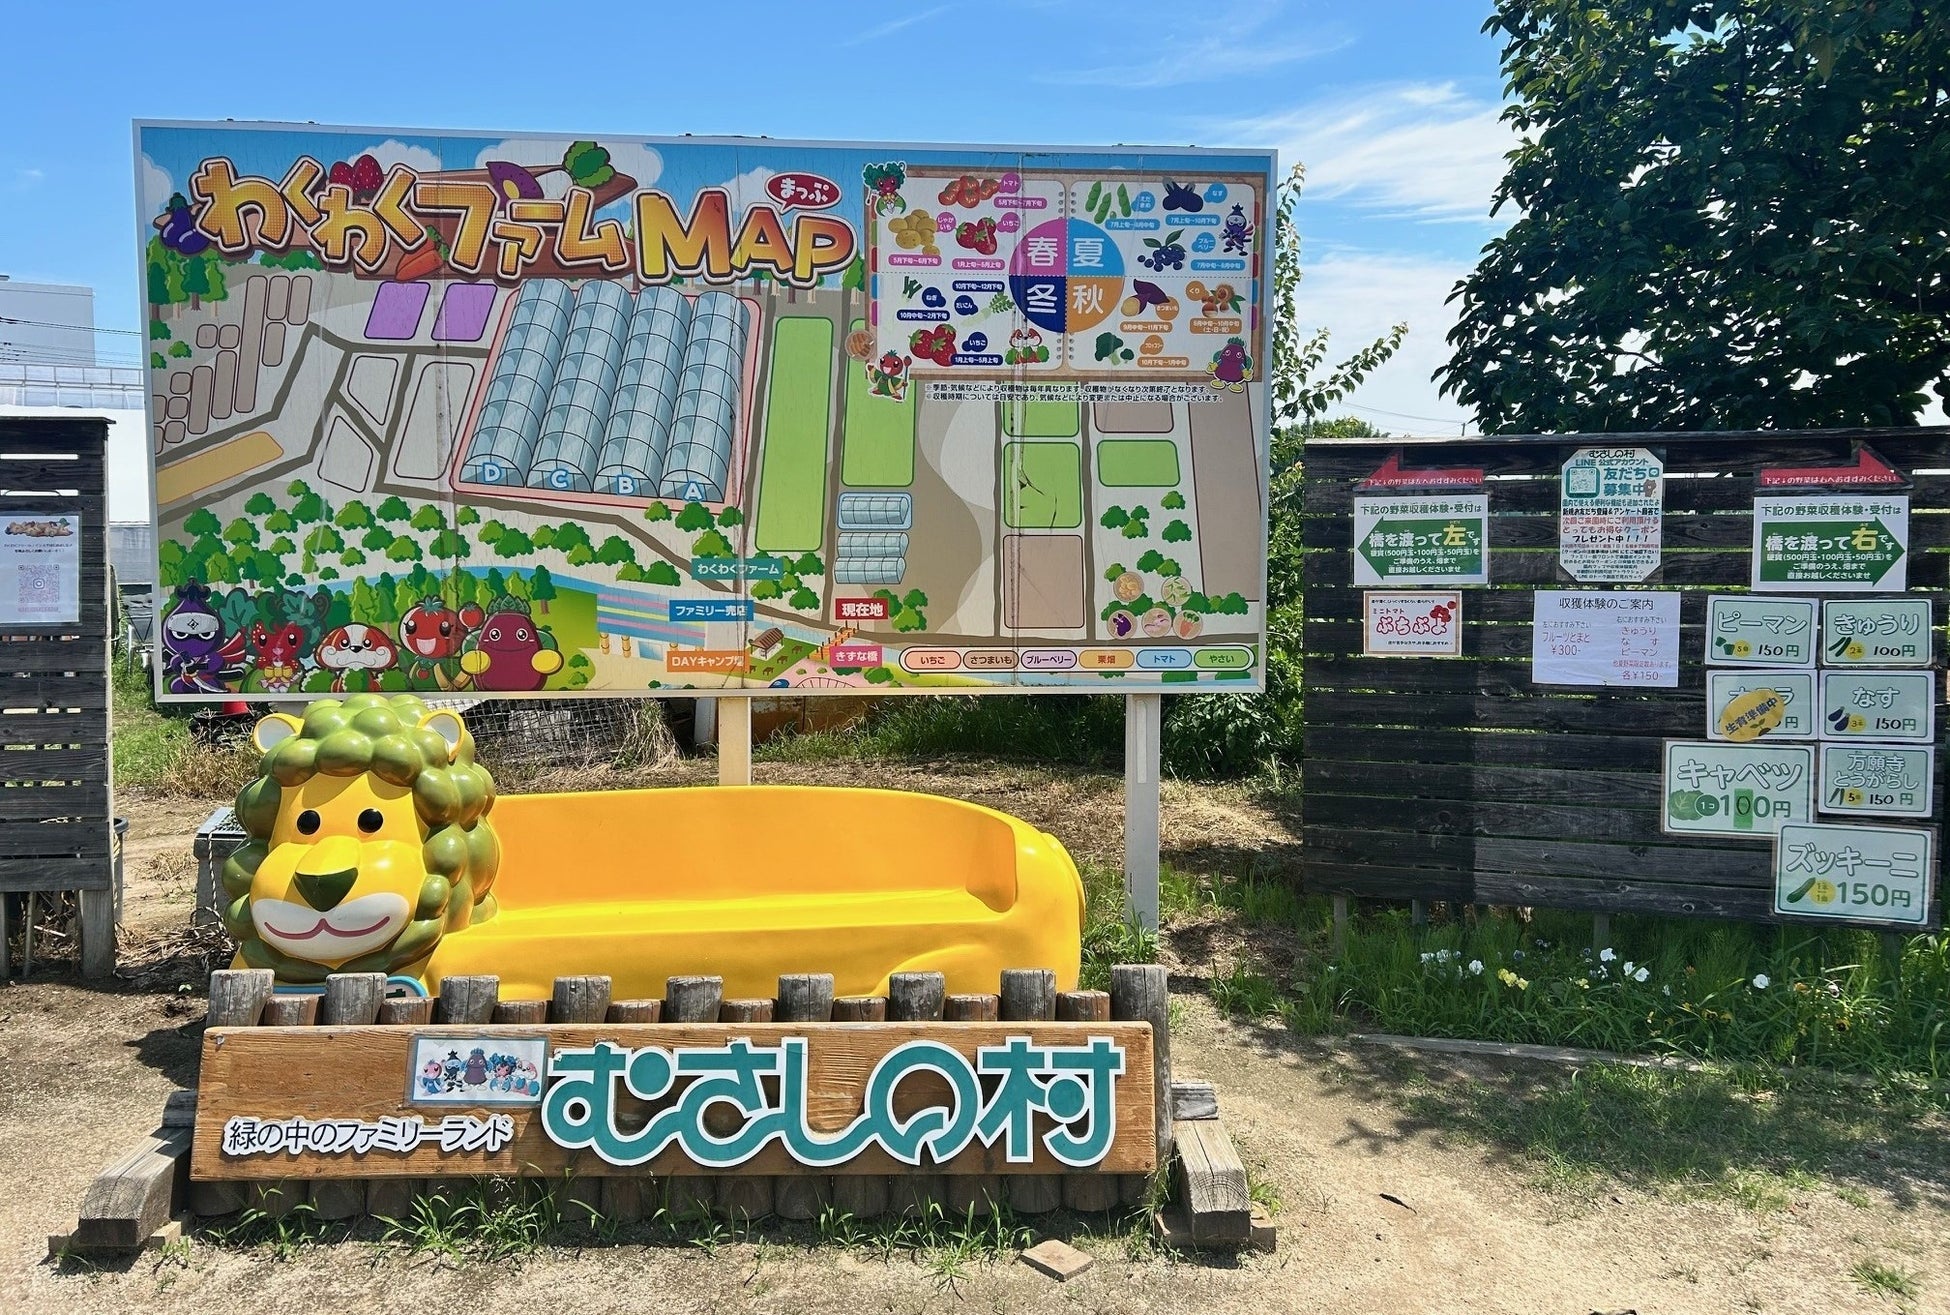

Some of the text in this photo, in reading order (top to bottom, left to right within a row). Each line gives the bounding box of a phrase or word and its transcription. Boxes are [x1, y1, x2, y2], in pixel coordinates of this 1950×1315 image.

[780, 177, 829, 203] まっぷ
[1002, 219, 1020, 227] いちご
[635, 186, 857, 287] MAP
[1027, 236, 1058, 266] 春
[1072, 237, 1105, 268] 夏
[926, 293, 938, 301] ねぎ
[1189, 286, 1201, 295] くり
[1026, 283, 1058, 314] 冬
[1072, 284, 1104, 315] 秋
[1588, 450, 1635, 458] むさしの村
[483, 464, 501, 482] D
[551, 470, 568, 487] C
[1604, 467, 1647, 480] 友だち
[618, 477, 635, 494] B
[685, 482, 703, 500] A
[1604, 483, 1644, 496] 募集中
[1562, 526, 1658, 534] とってもお得なクーポン
[1765, 527, 1894, 551] 橋を渡って右です
[698, 564, 779, 574] わくわくファーム
[675, 605, 747, 616] ファミリー売店
[842, 603, 884, 617] 現在地
[1617, 616, 1667, 624] 右におすすみ下さい
[1717, 611, 1807, 635] ピーマン
[1834, 614, 1919, 635] きゅうり
[1543, 632, 1590, 643] フルーツとまと
[1622, 627, 1657, 636] きゅうり
[1758, 644, 1799, 657] 150円
[1873, 645, 1916, 657] 100円
[672, 656, 743, 667] DAYキャンプ場
[920, 656, 946, 665] いちご
[970, 655, 1012, 665] さつまいも
[1026, 655, 1072, 665] ブルーベリー
[1096, 654, 1116, 664] 栗畑
[1153, 655, 1176, 665] トマト
[1208, 654, 1234, 664] やさい
[1852, 687, 1899, 709] なす
[1725, 697, 1778, 735] 生育準備中
[1875, 718, 1916, 731] 150円
[1848, 754, 1905, 773] 万願寺
[1677, 759, 1802, 791] キャベツ
[1833, 771, 1919, 790] とうがらし
[1720, 794, 1791, 818] 100円
[1869, 793, 1912, 805] 150円
[1786, 842, 1919, 876] ズッキーニ
[1837, 881, 1911, 907] 150円
[541, 1037, 1127, 1169] むさしの村
[228, 1118, 509, 1150] 緑の中のファミリーランド
